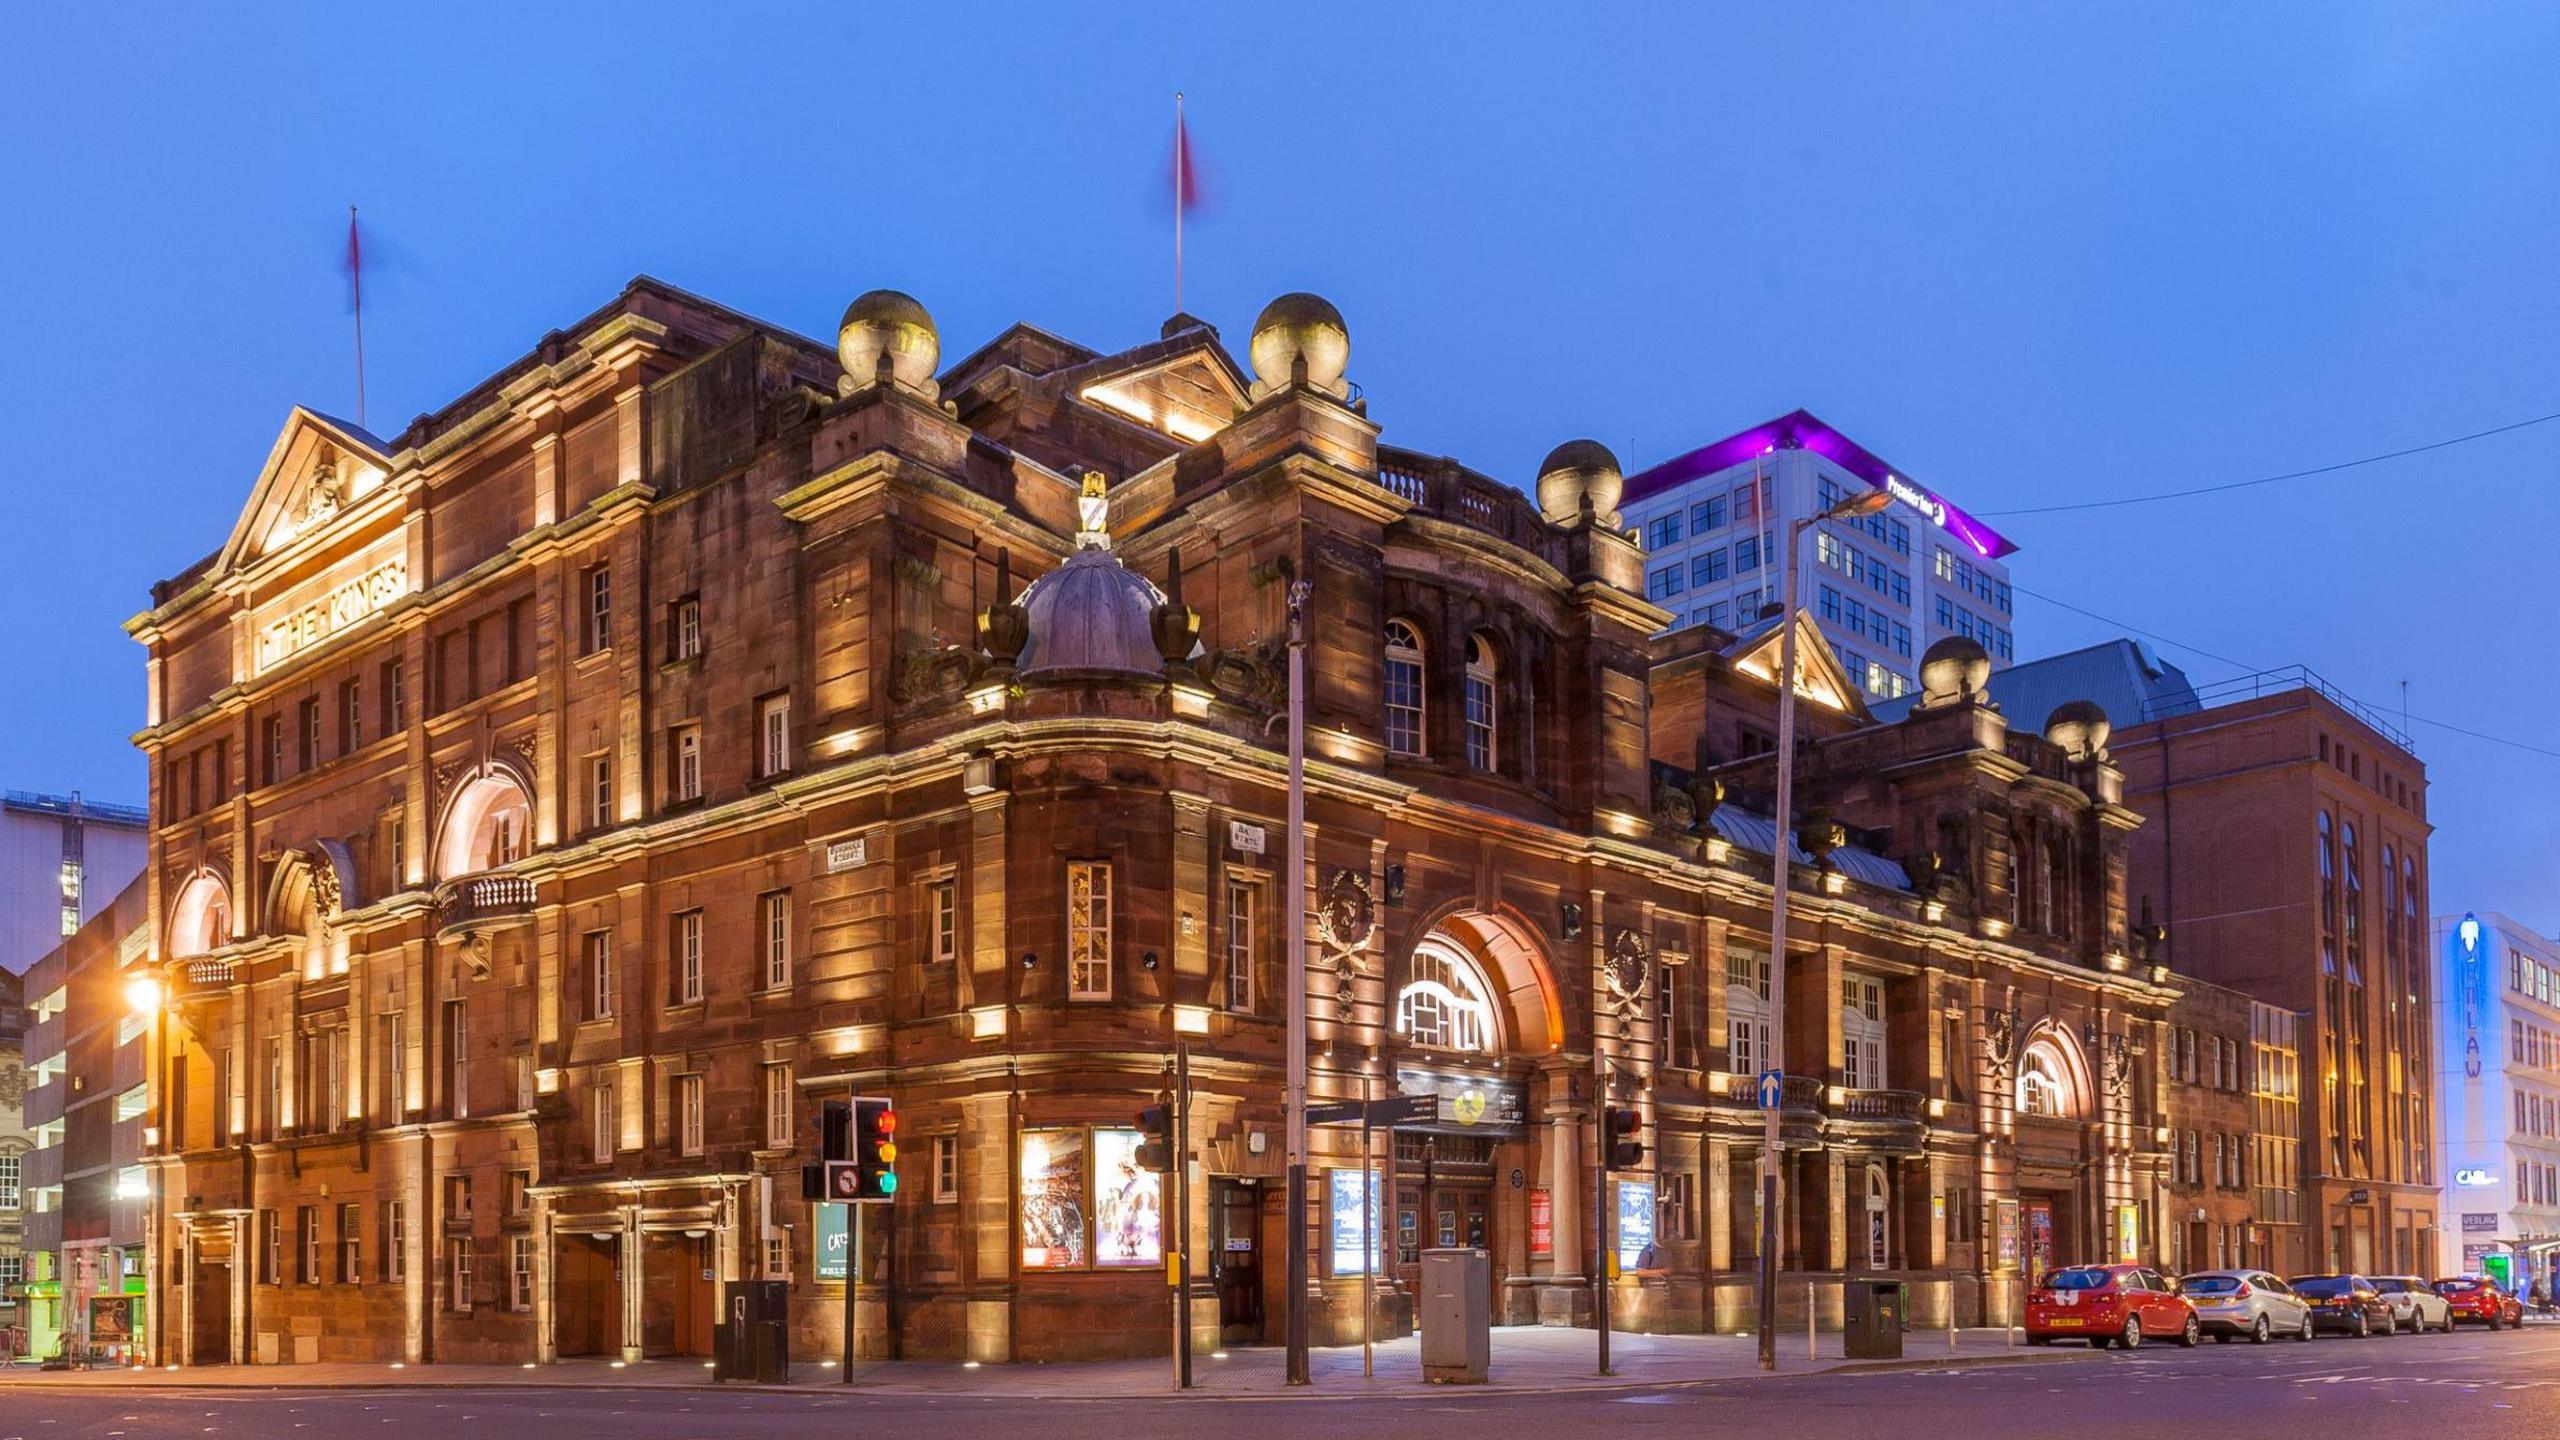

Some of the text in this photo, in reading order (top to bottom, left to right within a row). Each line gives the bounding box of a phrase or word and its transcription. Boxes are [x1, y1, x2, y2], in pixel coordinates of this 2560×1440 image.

[1888, 475, 1933, 516] Premier Inn
[272, 605, 317, 657] THE
